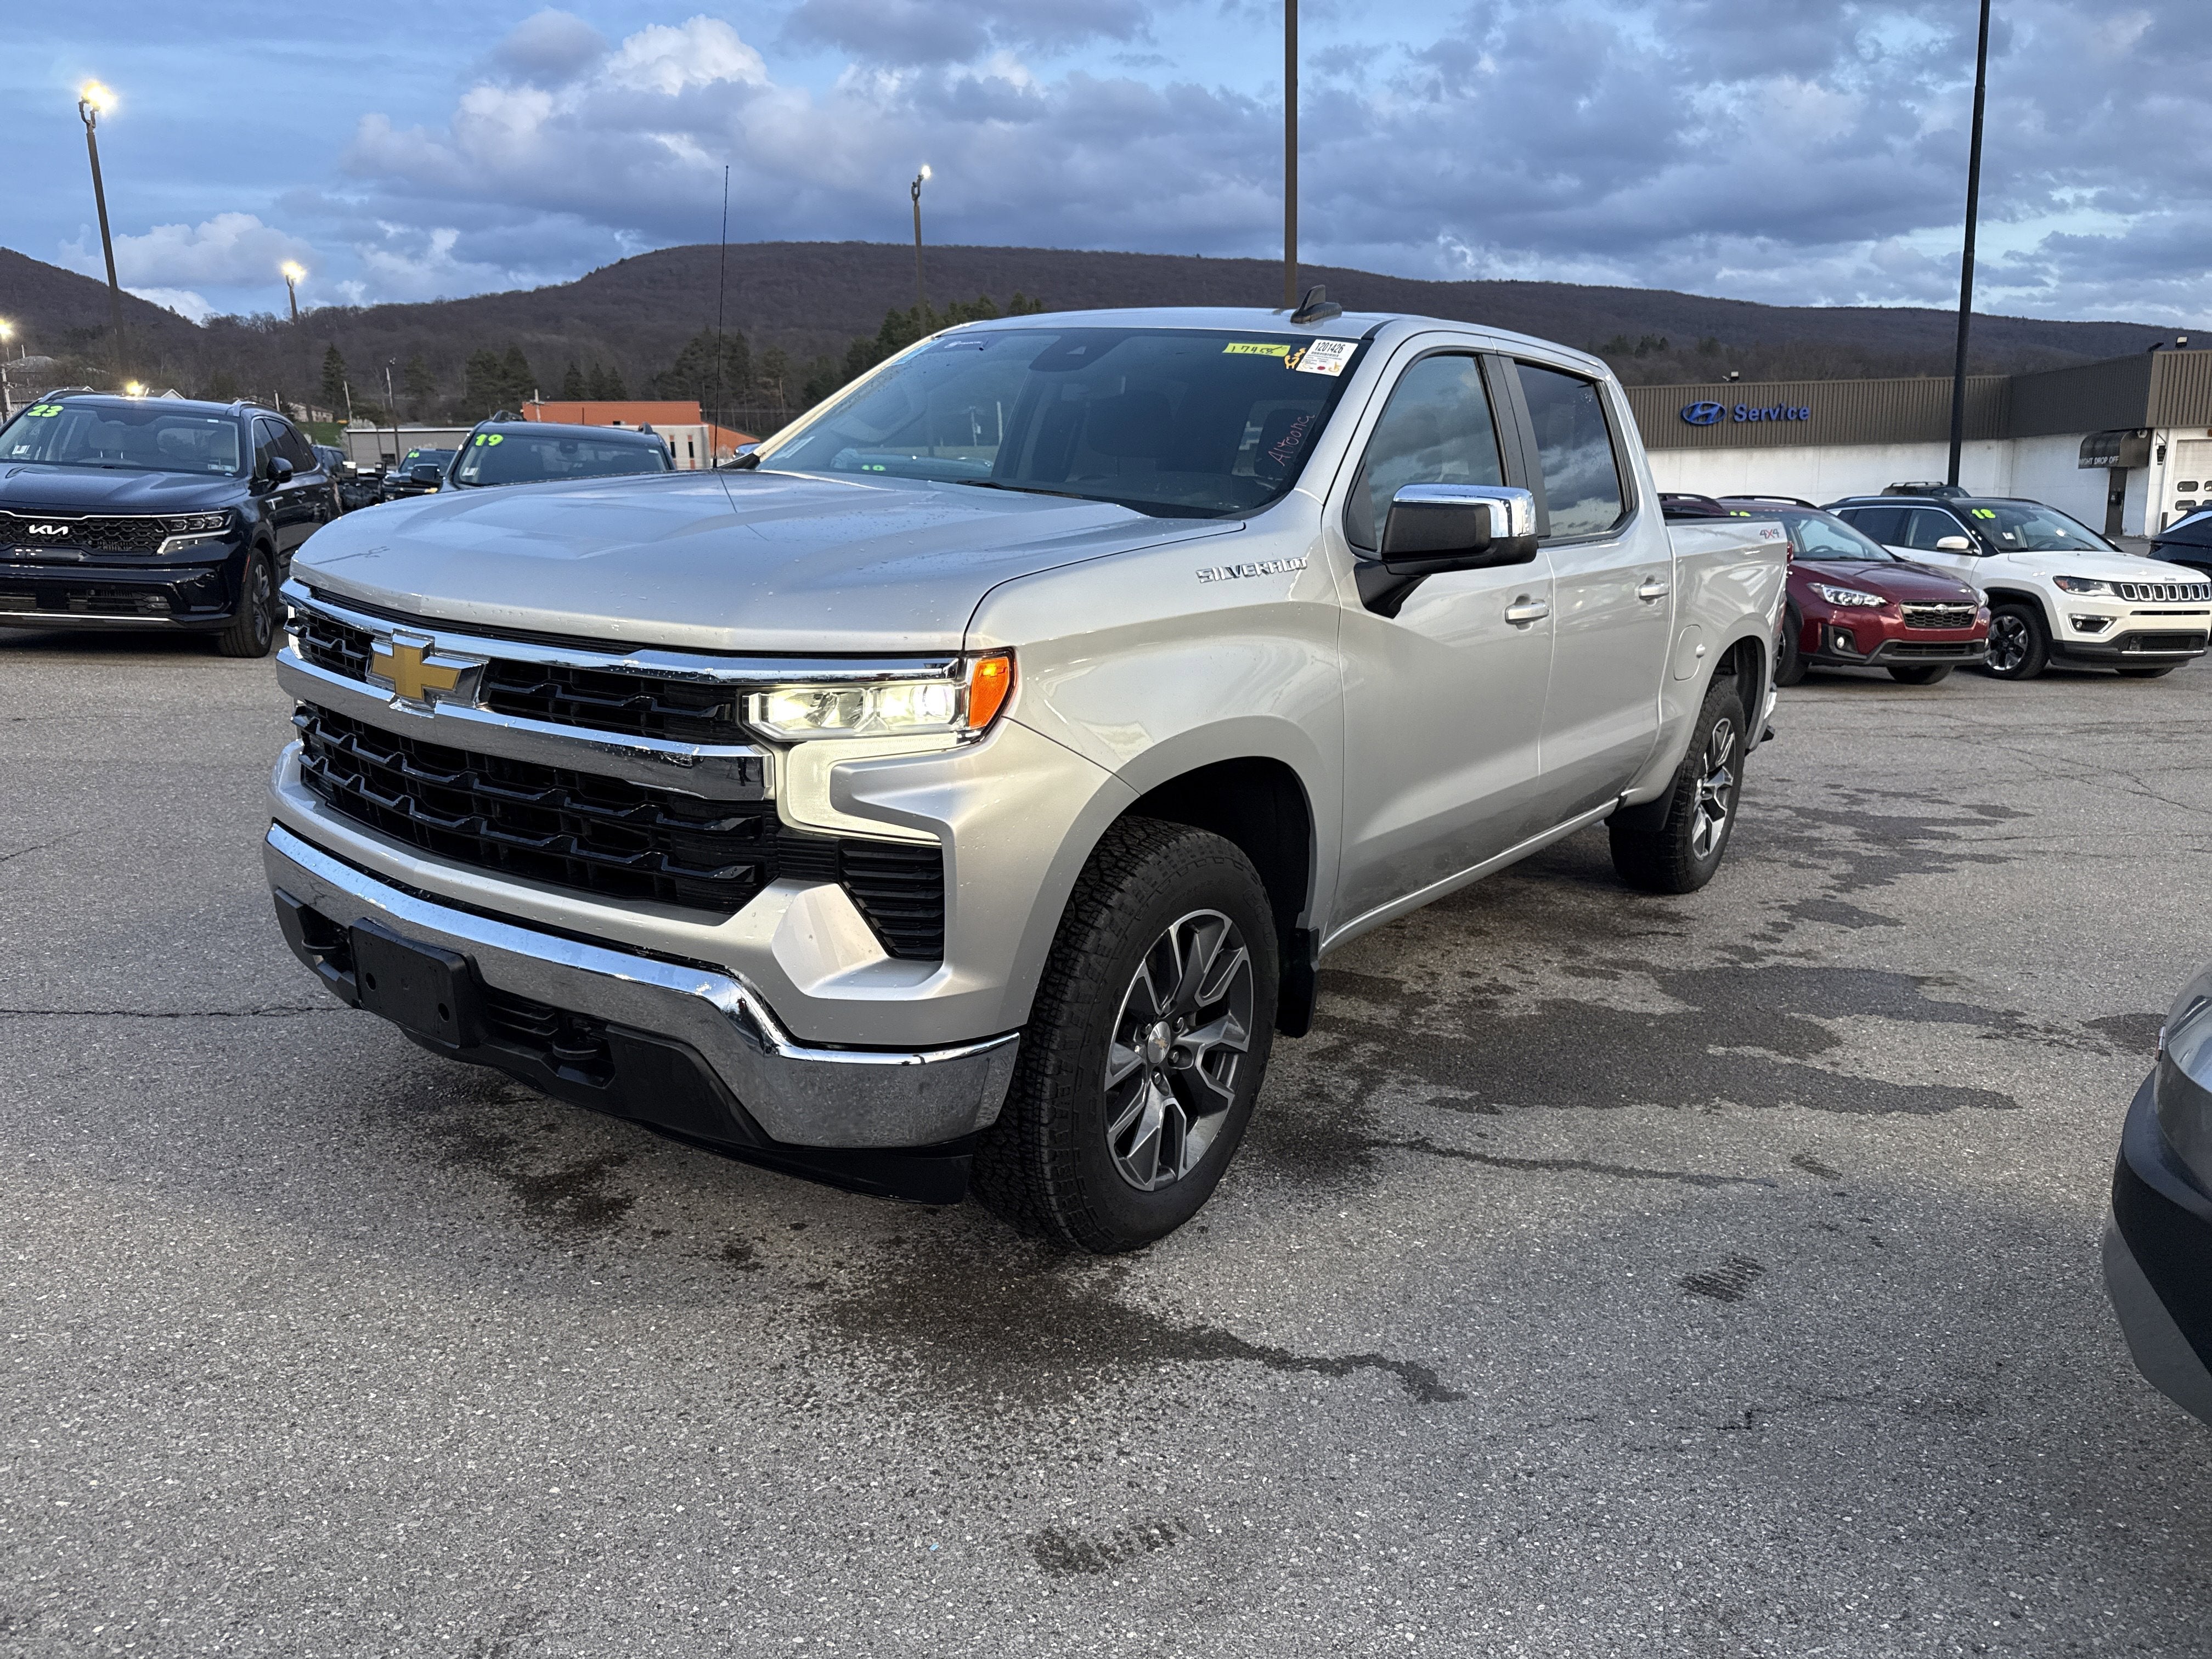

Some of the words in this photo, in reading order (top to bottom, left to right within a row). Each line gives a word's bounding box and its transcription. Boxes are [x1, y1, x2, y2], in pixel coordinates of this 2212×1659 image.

[1315, 342, 1346, 354] 1201426
[27, 404, 64, 417] 23
[1734, 403, 1809, 422] Service
[475, 434, 504, 446] 19
